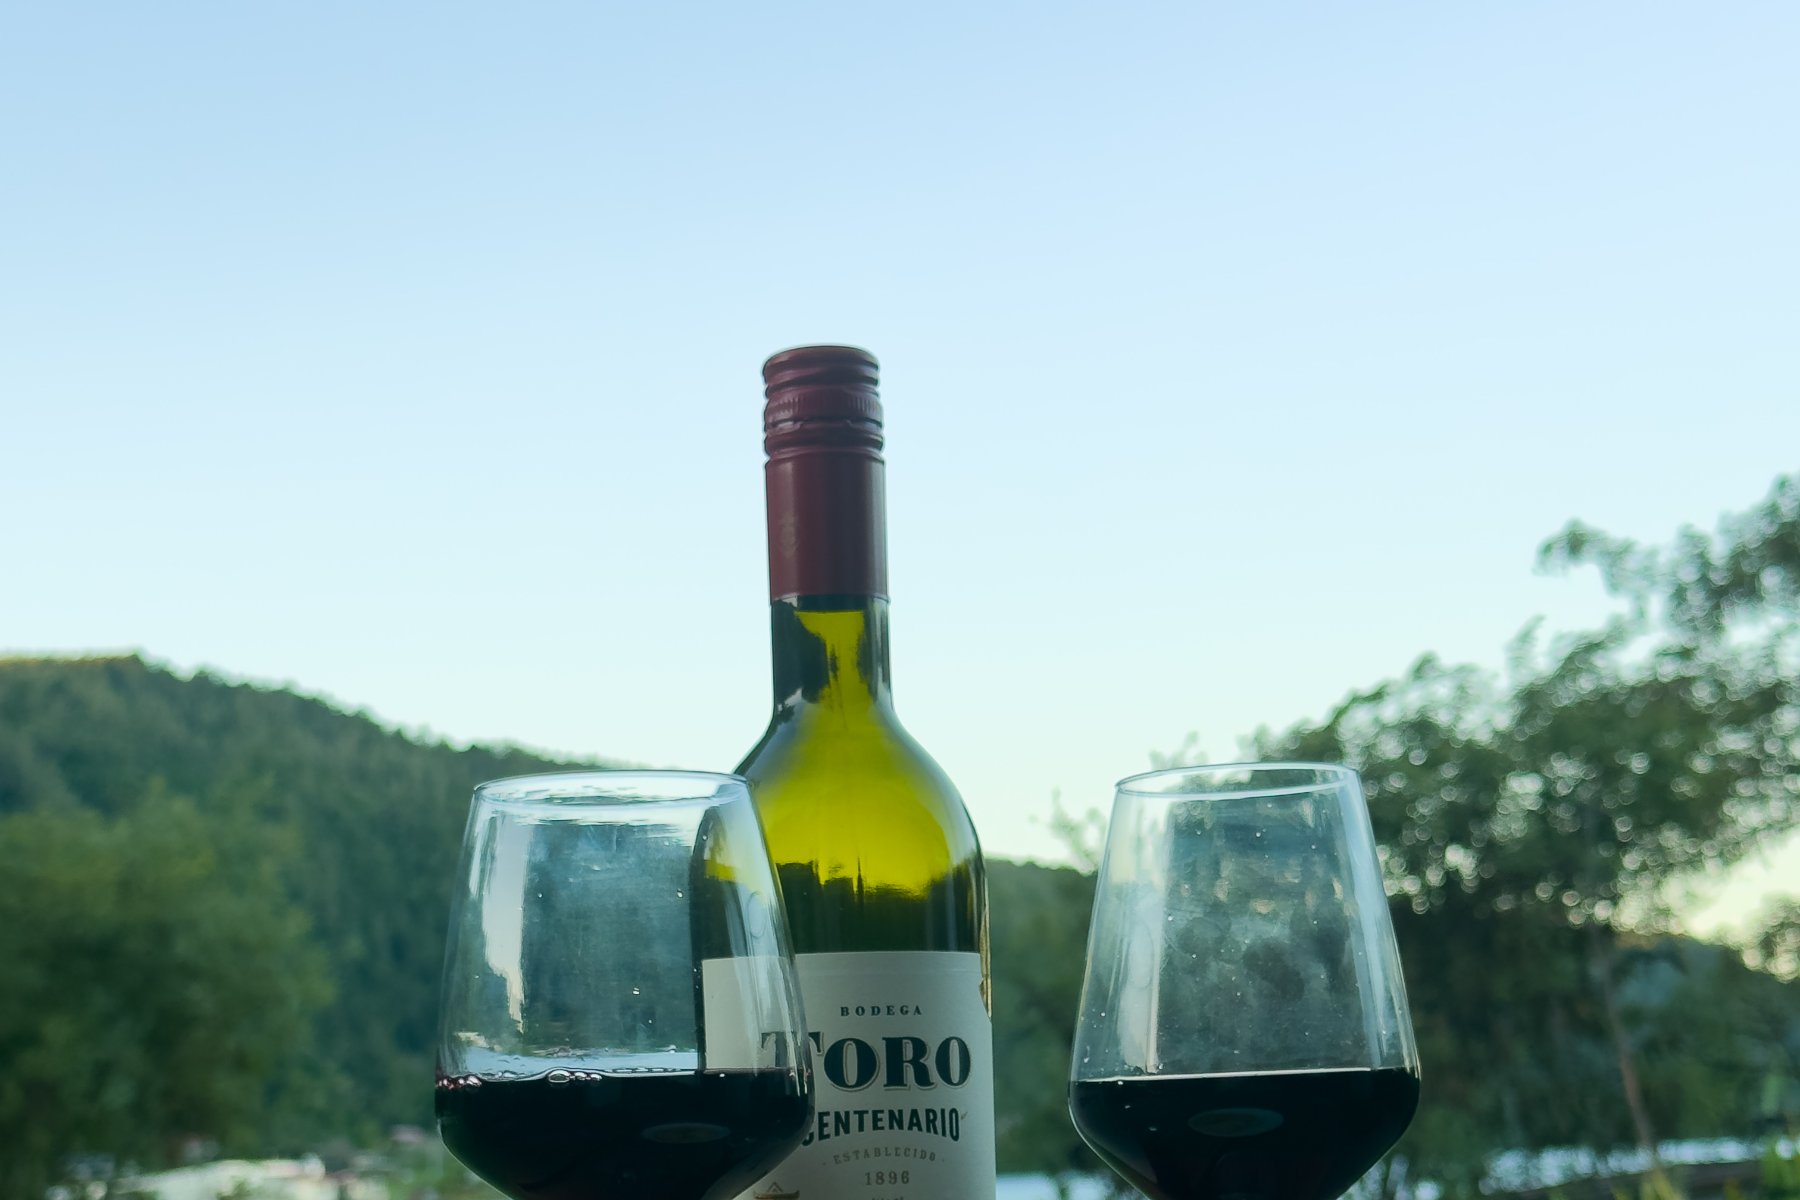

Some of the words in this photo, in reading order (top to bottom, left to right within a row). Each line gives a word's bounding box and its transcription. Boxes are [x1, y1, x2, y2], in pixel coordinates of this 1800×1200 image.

[840, 1005, 922, 1017] BODEGA
[760, 1031, 971, 1089] TORO
[833, 1147, 936, 1165] ESTABLECIDO
[865, 1170, 910, 1186] 1896
